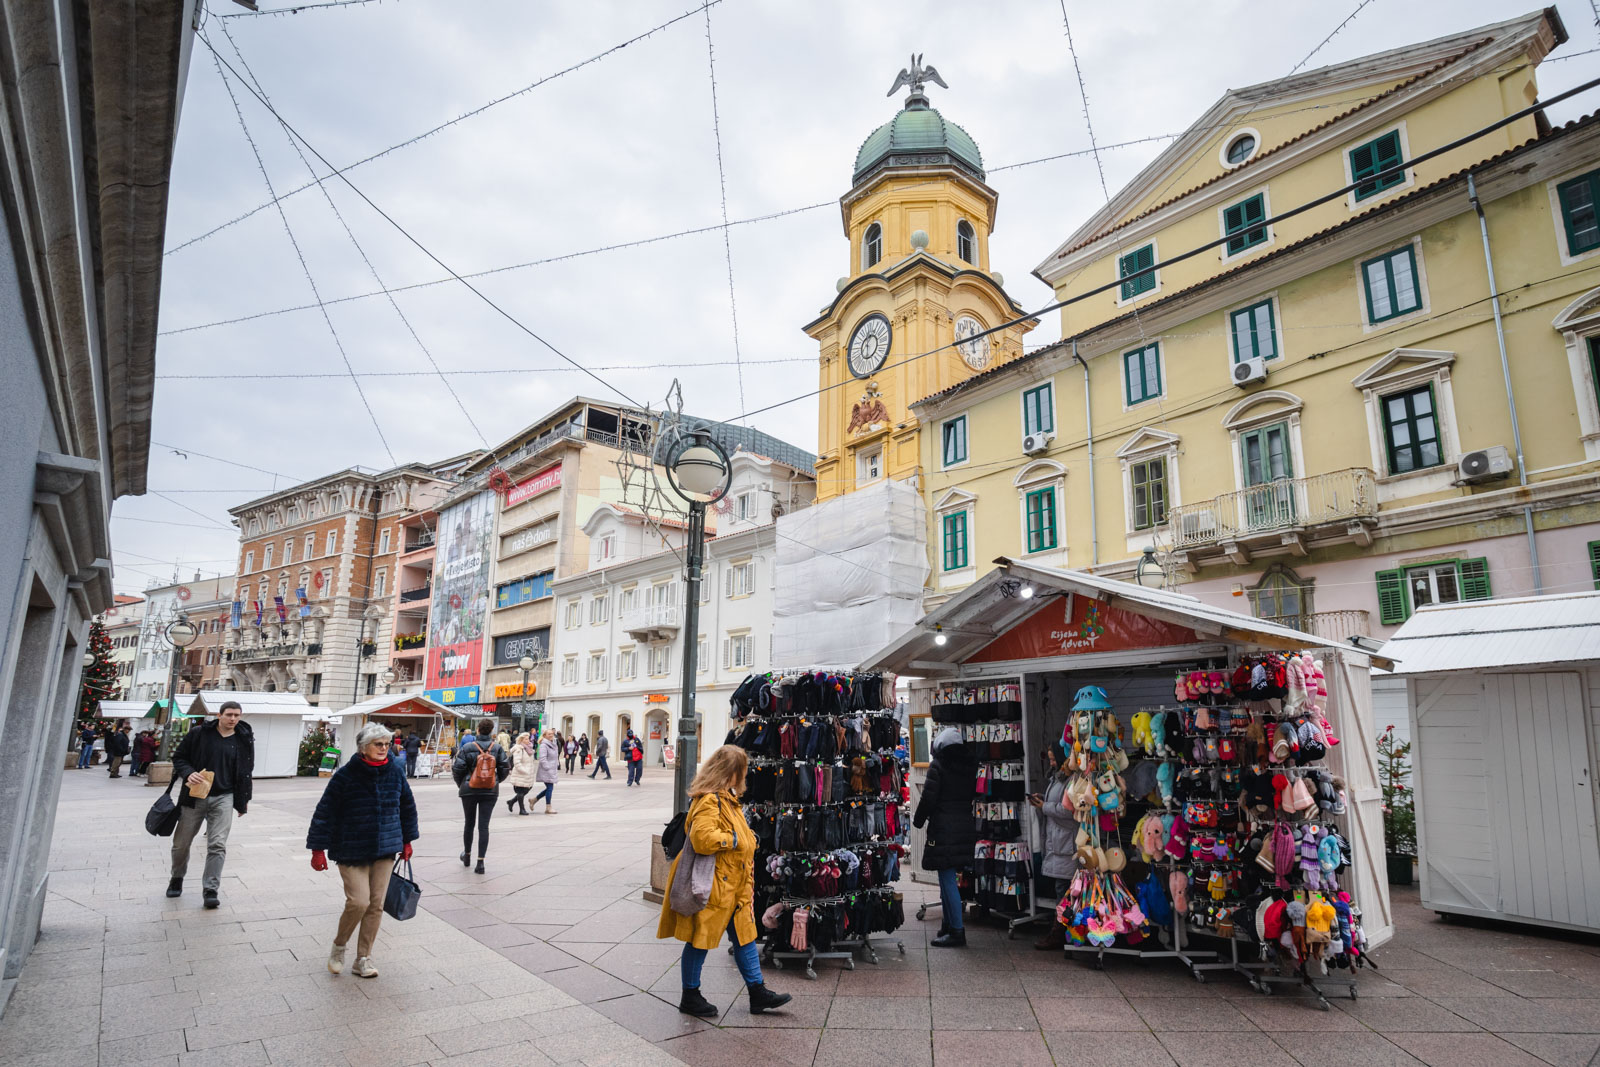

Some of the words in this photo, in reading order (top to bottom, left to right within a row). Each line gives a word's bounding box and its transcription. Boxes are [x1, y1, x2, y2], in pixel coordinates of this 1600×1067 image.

[512, 535, 525, 551] naš
[533, 528, 550, 543] dom
[494, 682, 536, 698] KORZO
